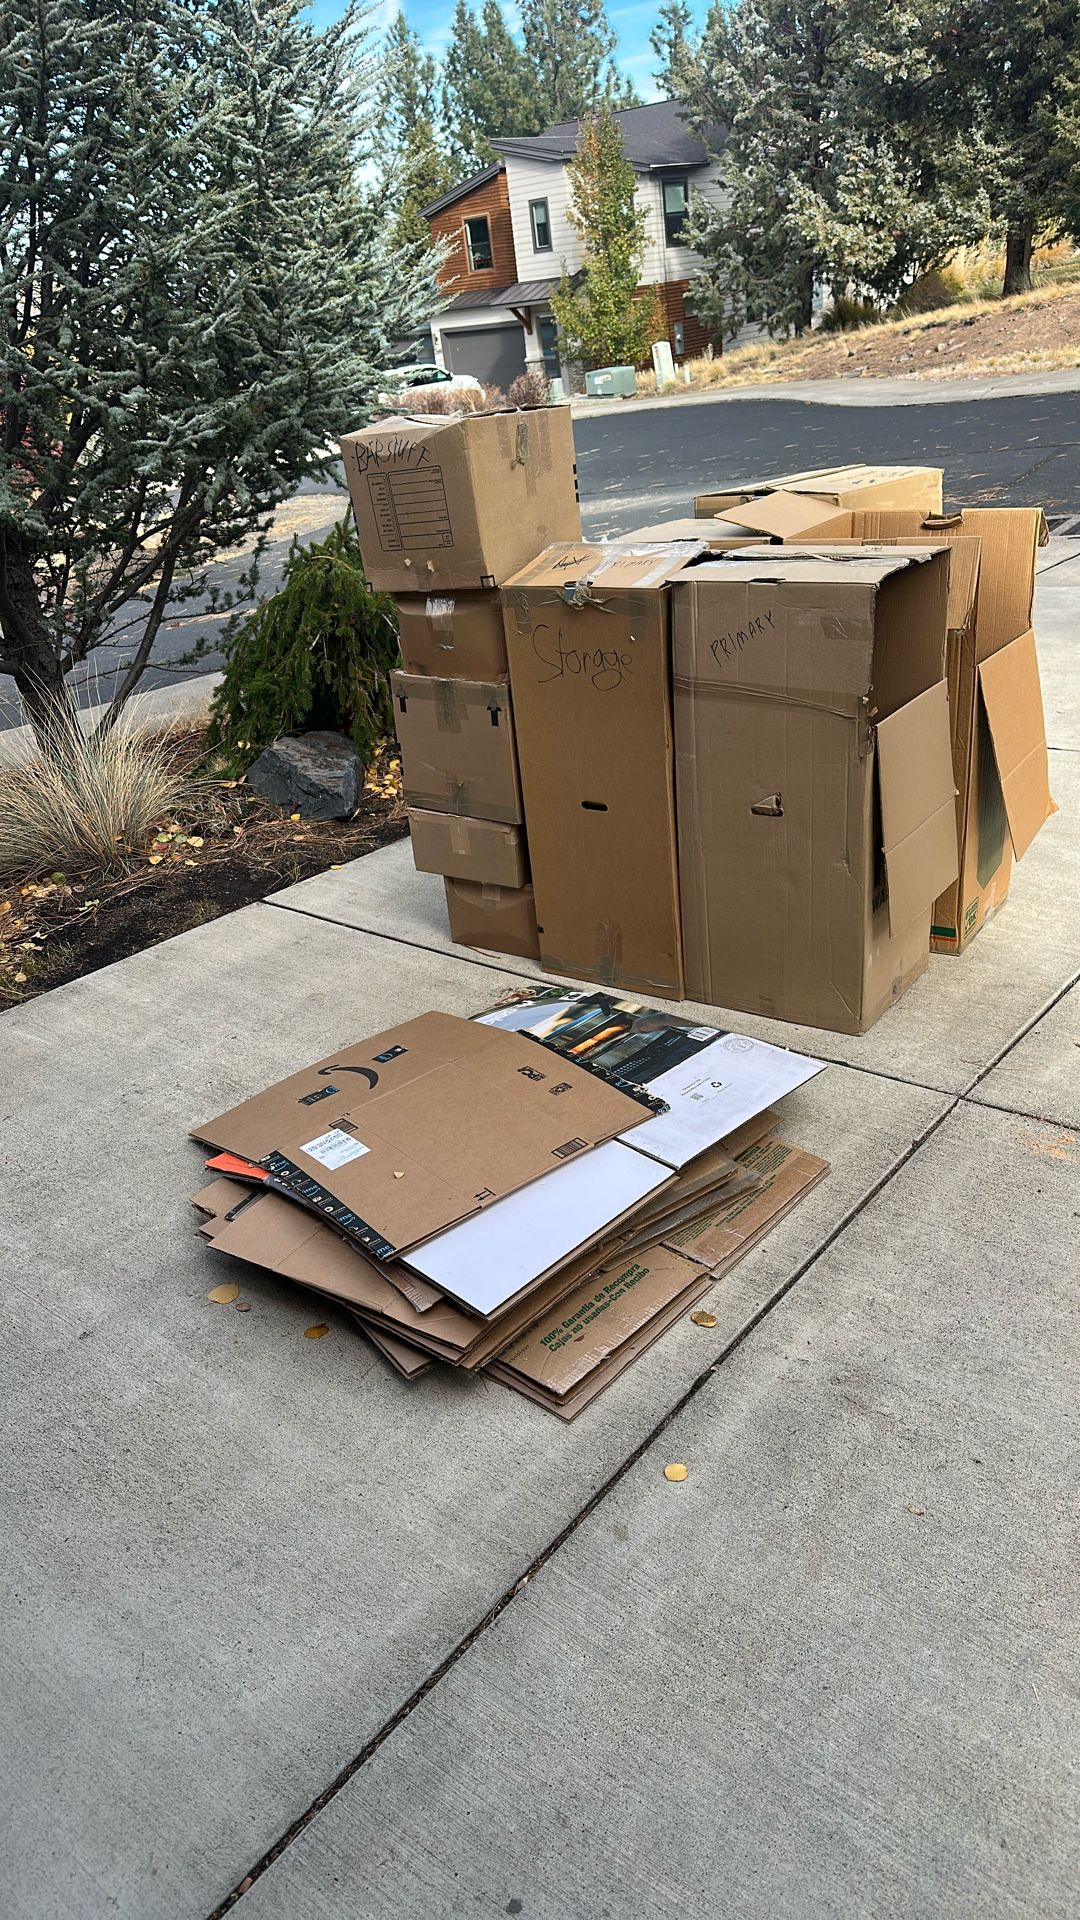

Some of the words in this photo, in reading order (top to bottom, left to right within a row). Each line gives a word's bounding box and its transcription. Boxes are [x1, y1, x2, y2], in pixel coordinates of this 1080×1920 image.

[532, 624, 633, 691] Storage
[710, 609, 776, 668] PRIMARY
[540, 1327, 564, 1346] 100%
[594, 1293, 606, 1303] de
[603, 1263, 641, 1294] Recompra
[549, 1333, 573, 1352] Cajas
[572, 1324, 584, 1334] no
[623, 1268, 650, 1290] Recibo
